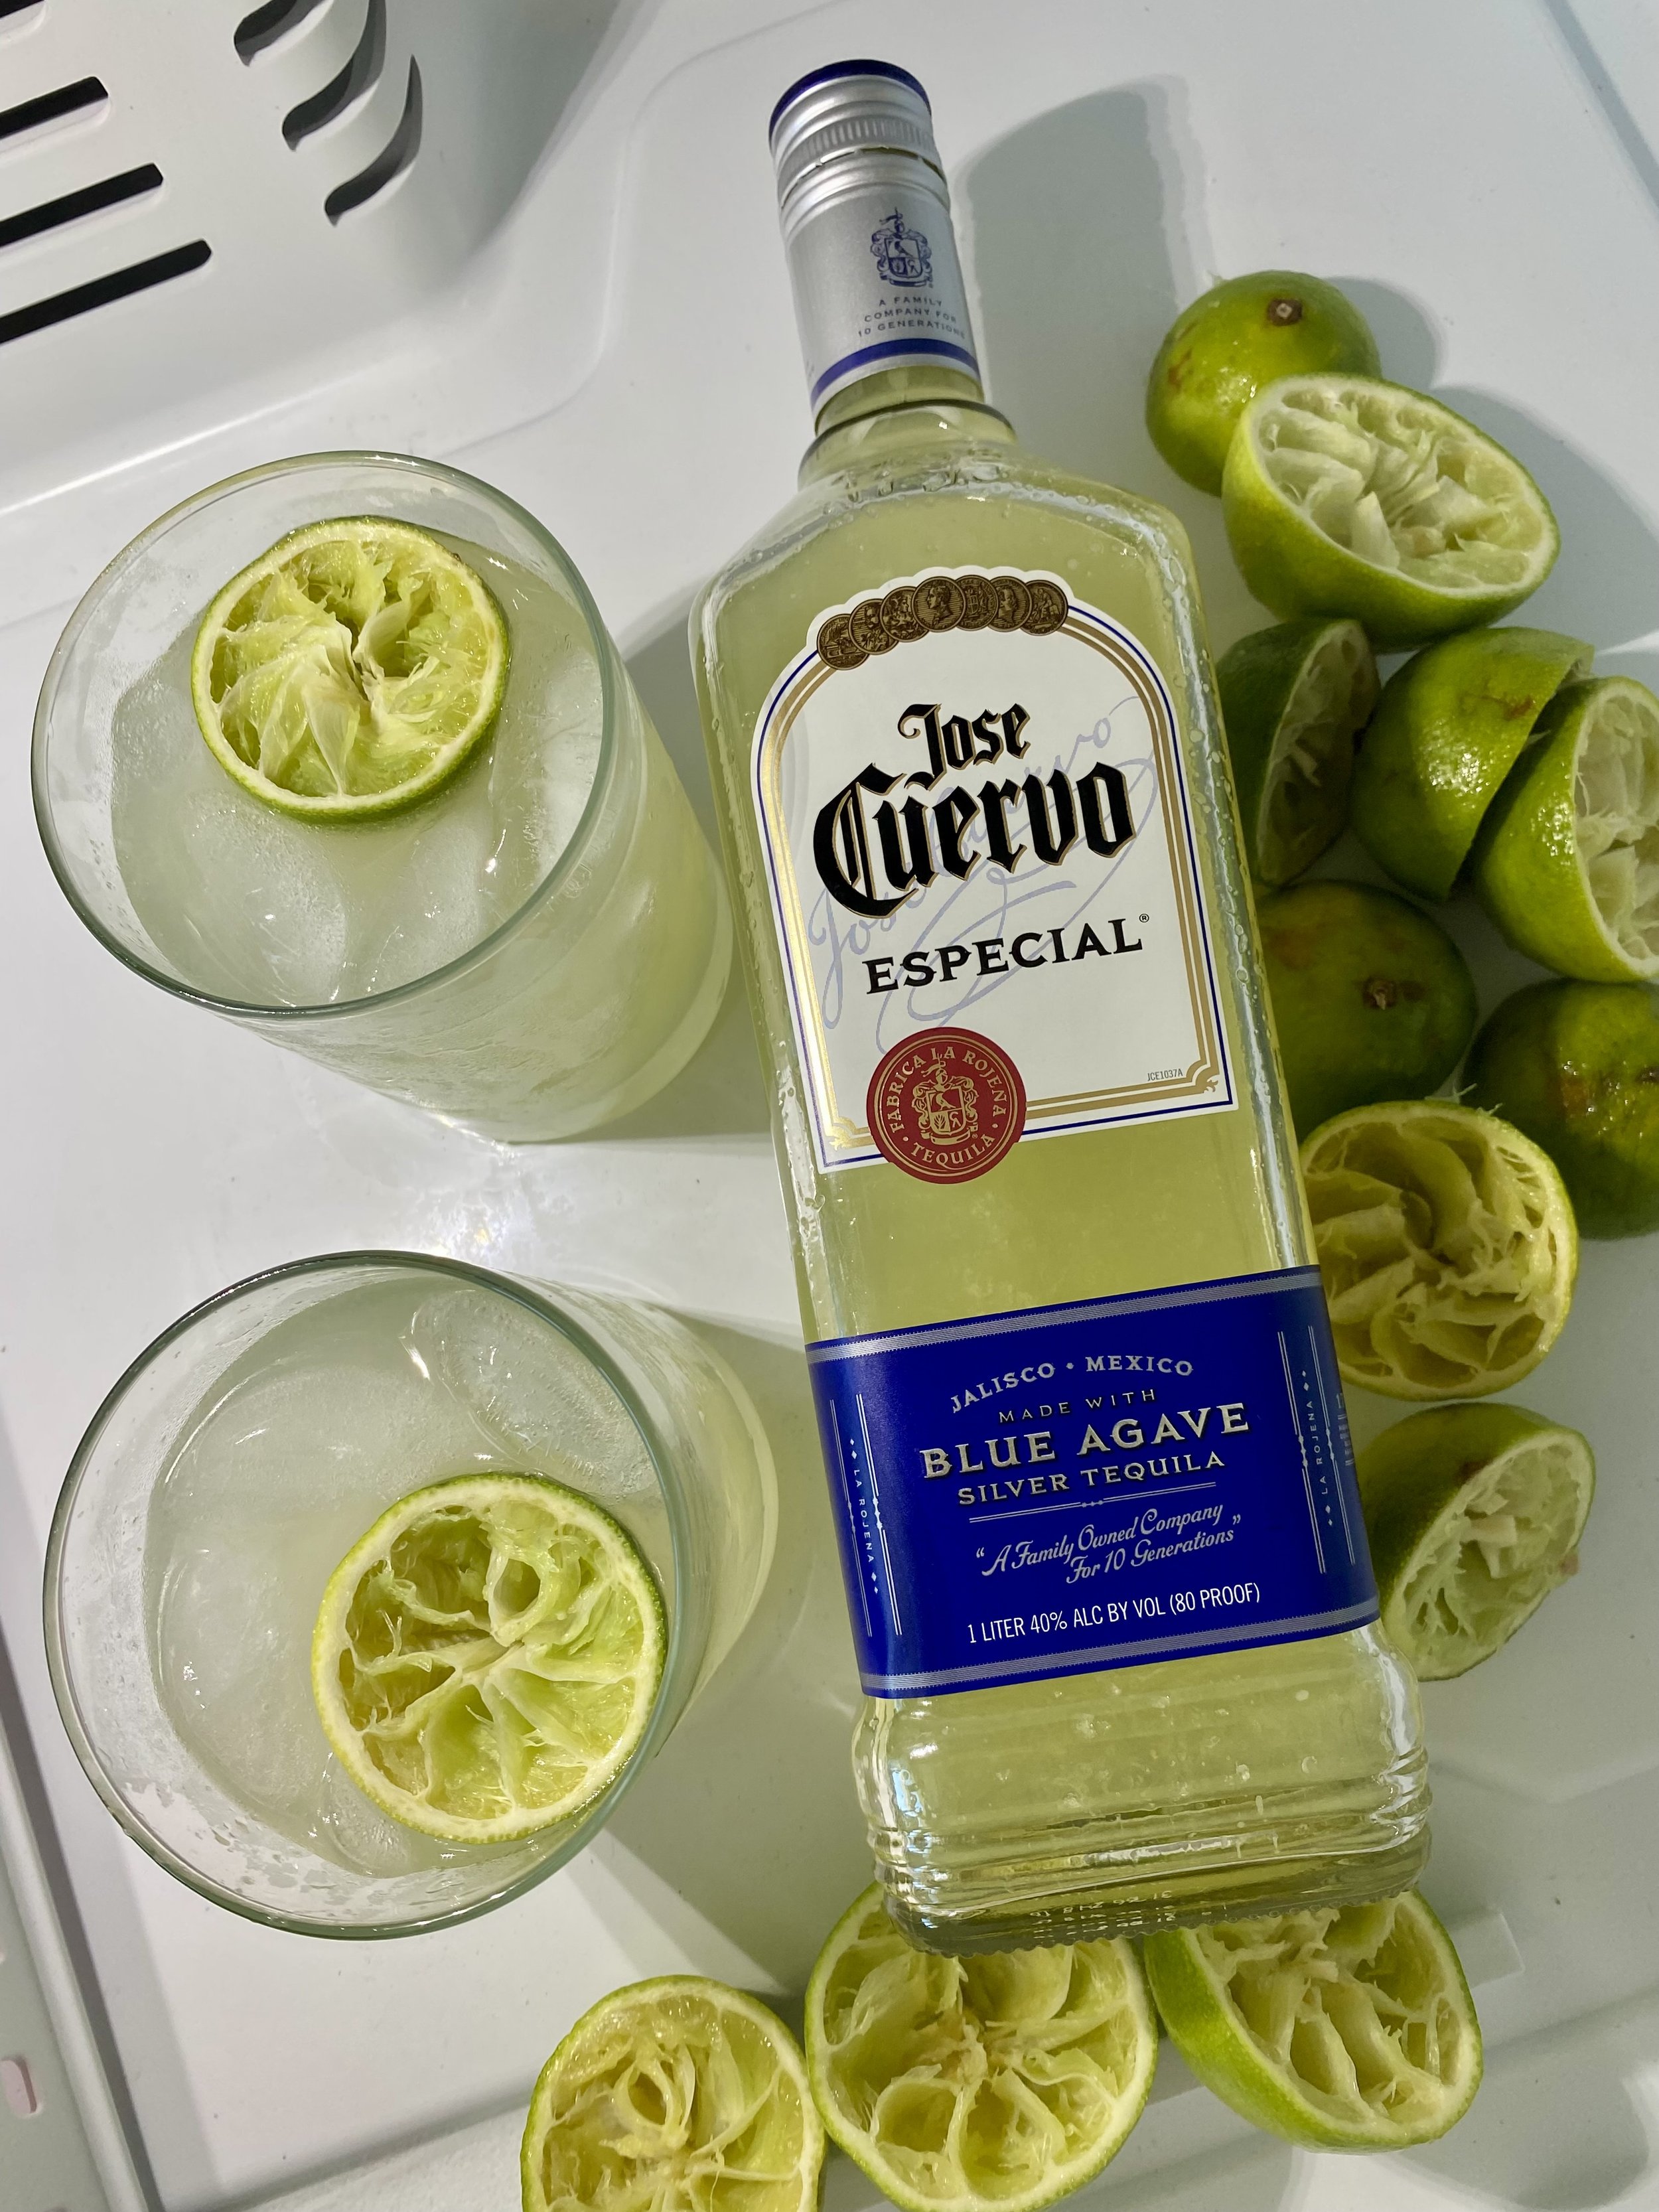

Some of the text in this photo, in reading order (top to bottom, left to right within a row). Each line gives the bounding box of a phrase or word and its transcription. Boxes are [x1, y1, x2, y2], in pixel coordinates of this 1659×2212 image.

[858, 320, 966, 339] 10 GENERATIONS
[865, 308, 956, 323] COMPANY FOR
[894, 297, 942, 307] FAMILY
[898, 703, 1031, 790] Jose
[813, 762, 1136, 919] Cuervo
[887, 1046, 1007, 1133] FABRICA LA ROJENA
[1147, 1069, 1183, 1081] JCE1037A
[911, 1134, 995, 1170] TEQUILA
[950, 1355, 1194, 1413] JALISCO MEXICO
[999, 1389, 1156, 1423] MADE WITH
[920, 1402, 1249, 1478] BLUE AGAVE
[1307, 1401, 1328, 1495] LA ROJENA
[958, 1451, 1224, 1505] SILVER TEQUILA
[853, 1469, 875, 1562] LA ROJENA
[1011, 1535, 1075, 1569] Family
[1078, 1516, 1139, 1552] Owned
[1140, 1504, 1224, 1534] Company
[1066, 1556, 1100, 1584] For
[1104, 1548, 1126, 1574] 10
[968, 1582, 1260, 1643] 1 LITER 40% ALC BY VOL (80 PROOF)
